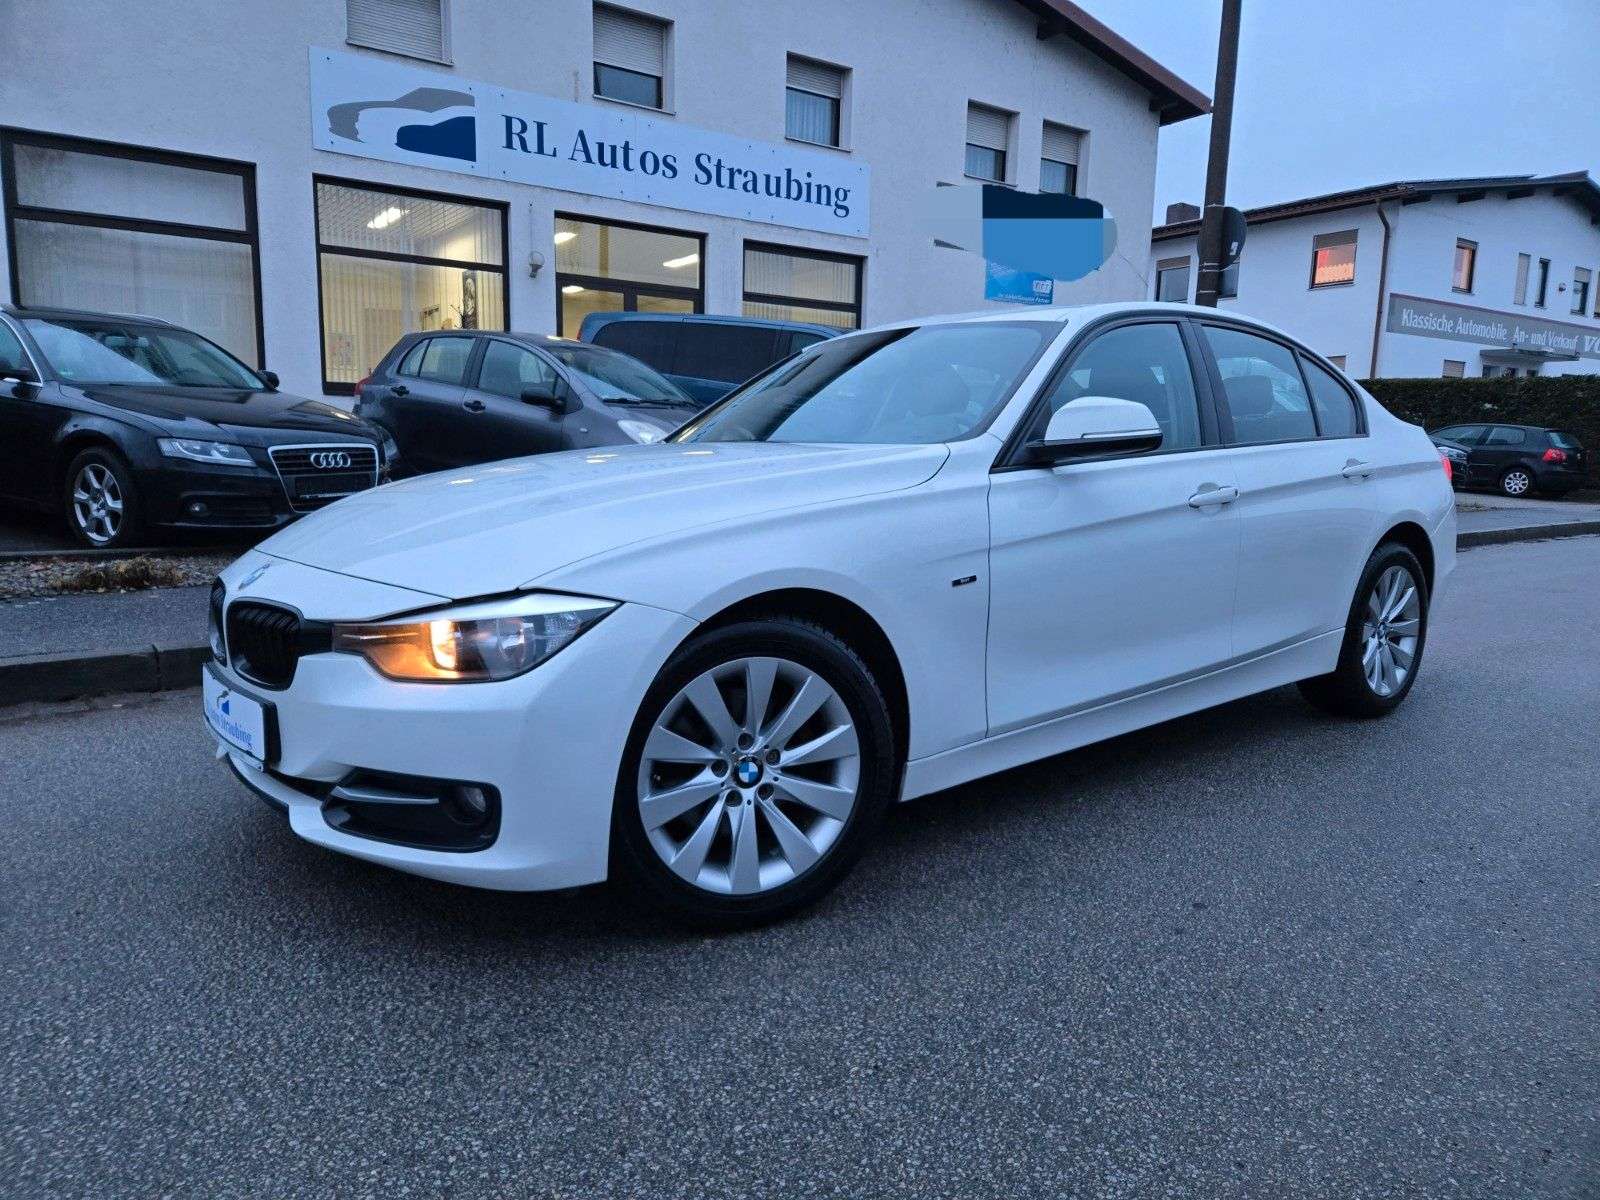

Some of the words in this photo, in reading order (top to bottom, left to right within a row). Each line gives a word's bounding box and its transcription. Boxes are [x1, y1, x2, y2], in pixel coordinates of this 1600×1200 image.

[502, 114, 557, 158] RL
[568, 129, 678, 179] Autos
[694, 152, 851, 218] Straubing
[1401, 308, 1454, 333] Klassische
[1455, 317, 1507, 341] Automobile
[1514, 326, 1529, 343] An-
[1531, 331, 1547, 346] und
